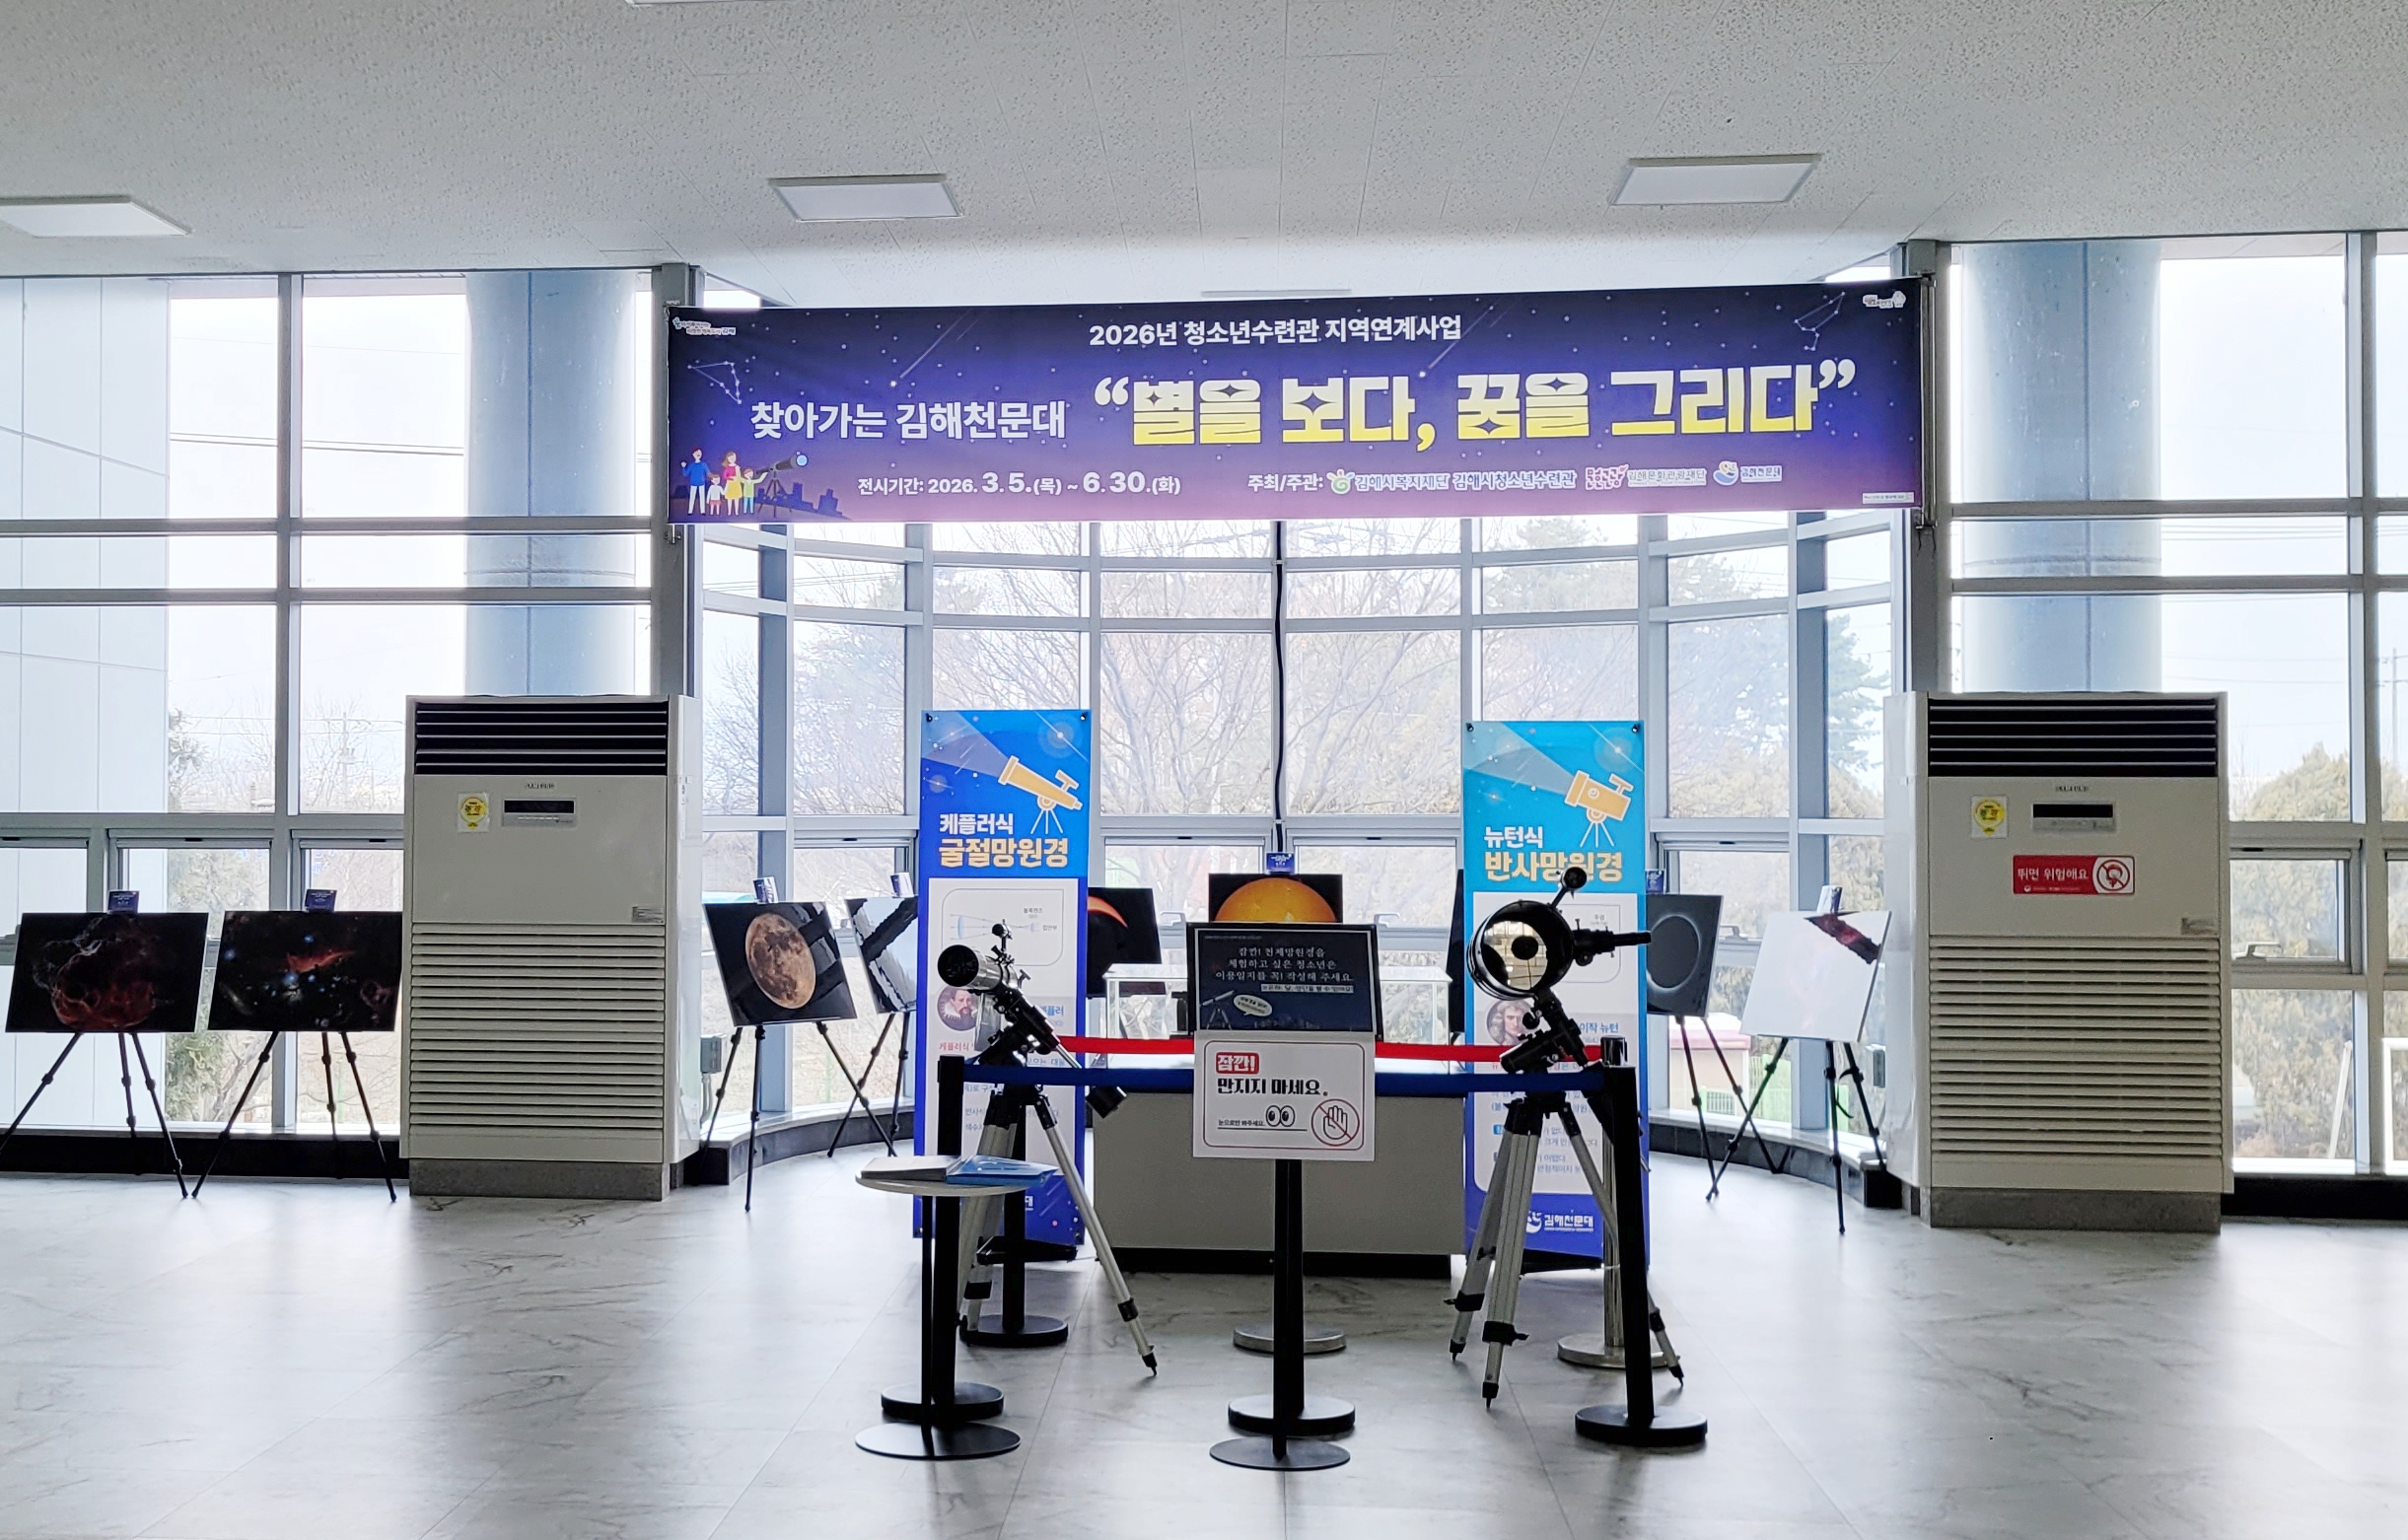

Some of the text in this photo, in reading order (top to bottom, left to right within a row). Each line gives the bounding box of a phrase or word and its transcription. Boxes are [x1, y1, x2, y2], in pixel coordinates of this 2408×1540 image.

[1089, 315, 1461, 346] 2026년 청소년수련관 지역연계사업
[1094, 359, 1856, 451] “별을 보다, 꿈을 그리다”
[750, 401, 1066, 440] 찾아가는 김해천문대
[858, 477, 924, 496] 전시기간:
[1247, 470, 1576, 492] 주최/주관: 김해시복지재단 김해시청소년수련관
[939, 812, 1014, 835] 케플러식
[1483, 825, 1544, 849] 뉴턴식
[938, 837, 1068, 869] 굴절망원경
[2044, 867, 2089, 881] 위험해요
[1218, 1055, 1255, 1072] 잠깐!
[1218, 1078, 1328, 1096] 만지지 마세요.
